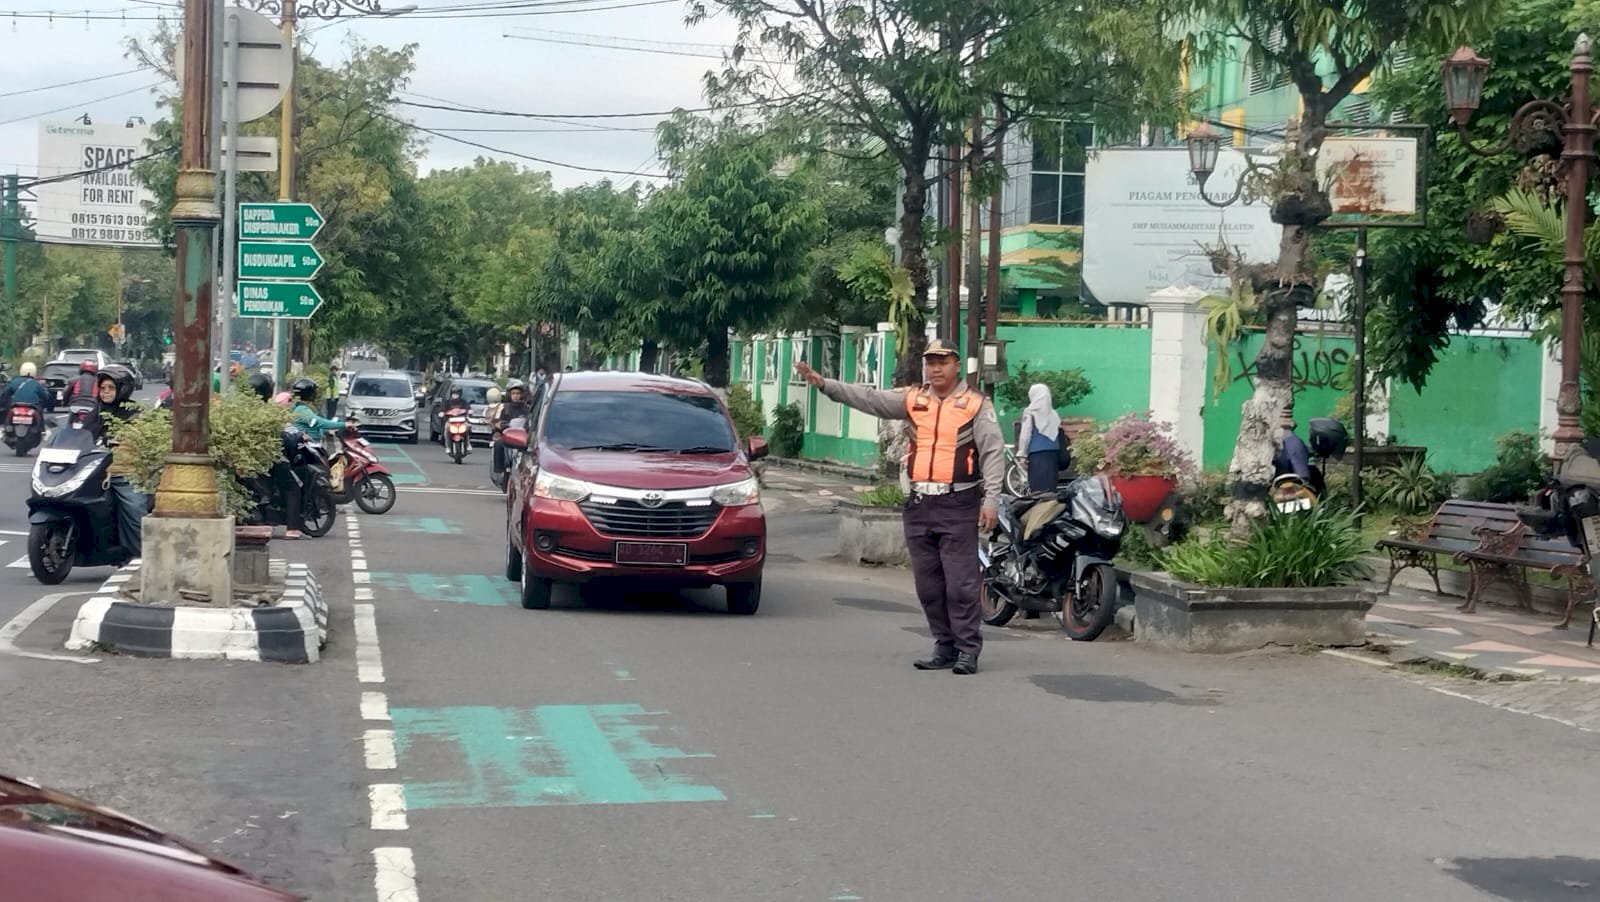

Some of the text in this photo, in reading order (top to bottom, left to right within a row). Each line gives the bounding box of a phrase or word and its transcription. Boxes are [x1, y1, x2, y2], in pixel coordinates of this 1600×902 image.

[84, 146, 135, 170] SPACE
[83, 172, 135, 187] AVAILABLE
[83, 188, 134, 204] FOR RENT
[1128, 191, 1172, 201] PIAGAM
[71, 212, 97, 225] 0815
[99, 214, 124, 226] 7613
[71, 227, 97, 240] 0812
[99, 228, 126, 241] 9887
[243, 253, 296, 267] DISDUKCAPIL
[243, 287, 268, 300] DINAS
